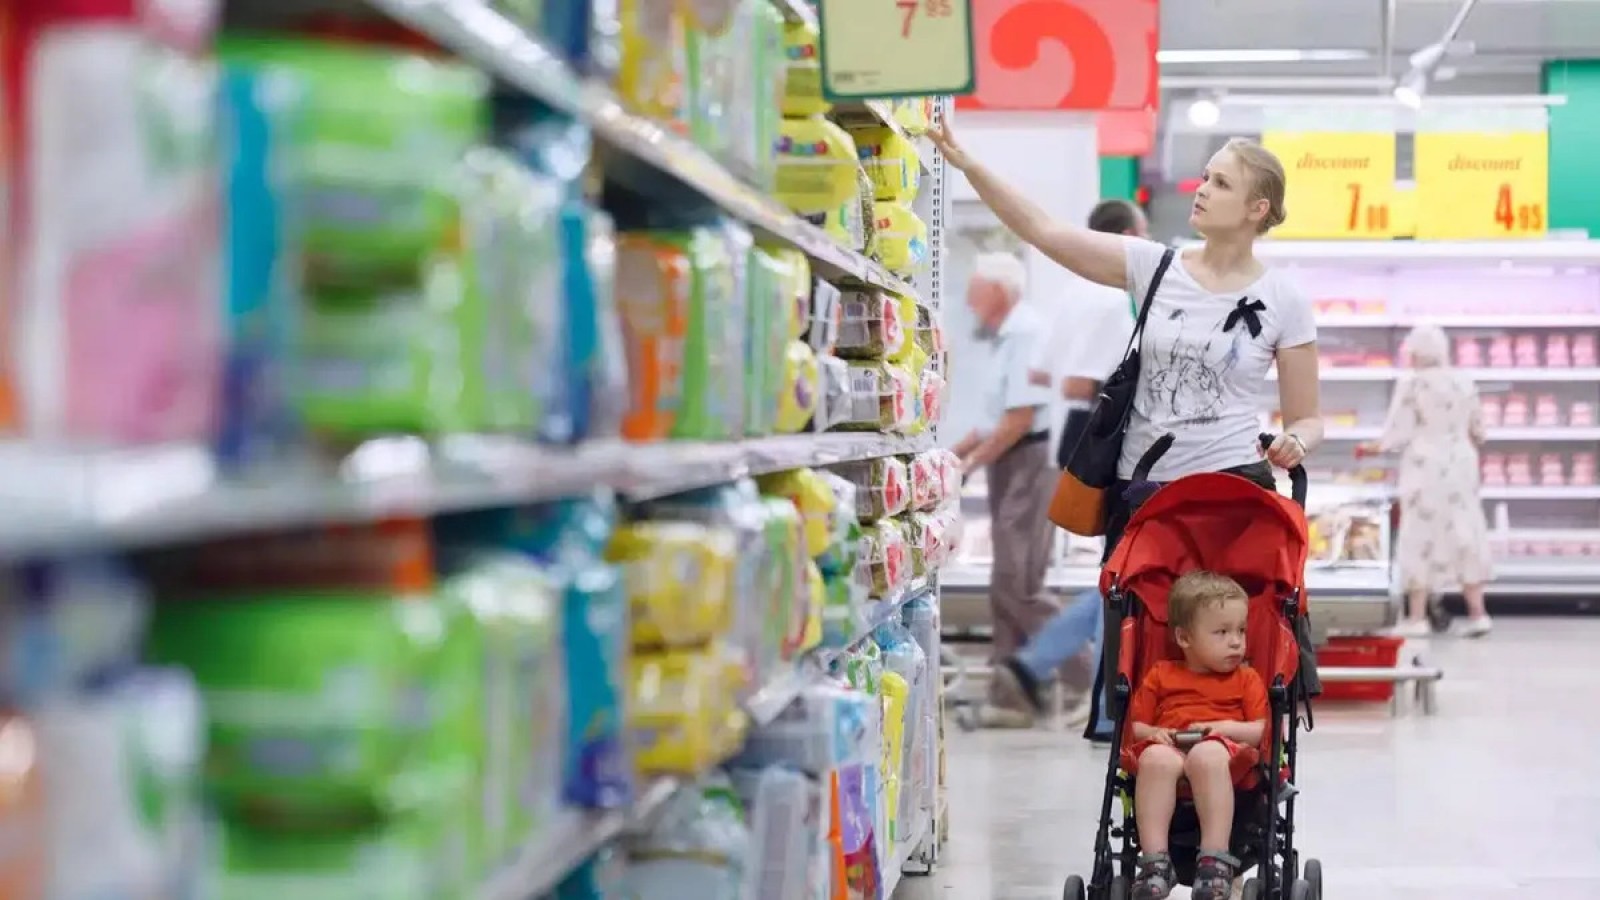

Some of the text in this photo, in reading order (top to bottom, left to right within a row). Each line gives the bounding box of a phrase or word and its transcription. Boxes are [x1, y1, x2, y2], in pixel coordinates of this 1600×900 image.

[895, 0, 919, 38] 7
[1296, 151, 1371, 170] discount
[1447, 152, 1523, 172] discount
